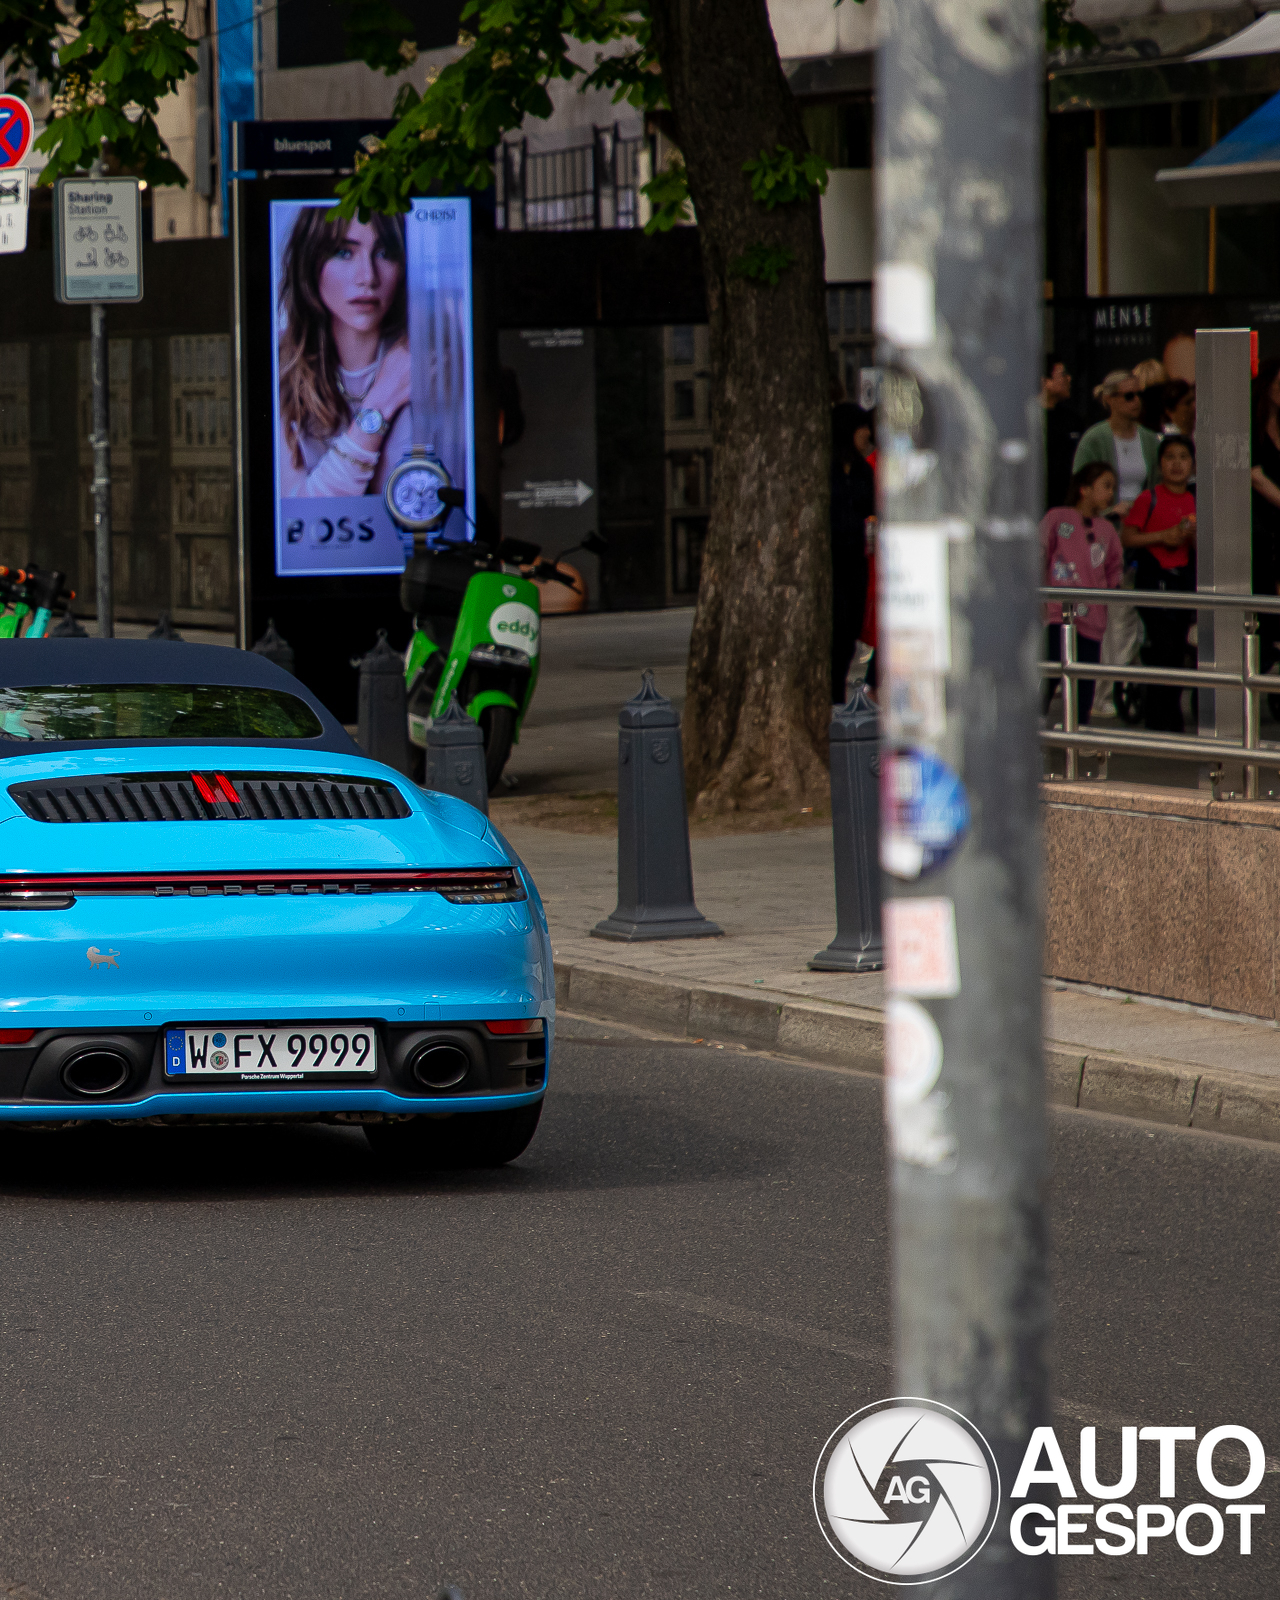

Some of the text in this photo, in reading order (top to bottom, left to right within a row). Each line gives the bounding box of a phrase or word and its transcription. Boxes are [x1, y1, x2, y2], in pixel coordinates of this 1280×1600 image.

[273, 138, 332, 154] bluespot
[68, 191, 113, 205] Sharing
[68, 204, 108, 215] Station
[415, 208, 457, 222] CHRIST
[2, 231, 9, 245] h
[287, 517, 376, 544] BOSS
[497, 619, 538, 642] eddy
[154, 883, 373, 896] PORSCHE
[172, 1033, 371, 1069] D W FX 9999
[280, 1072, 304, 1080] Wuppertal
